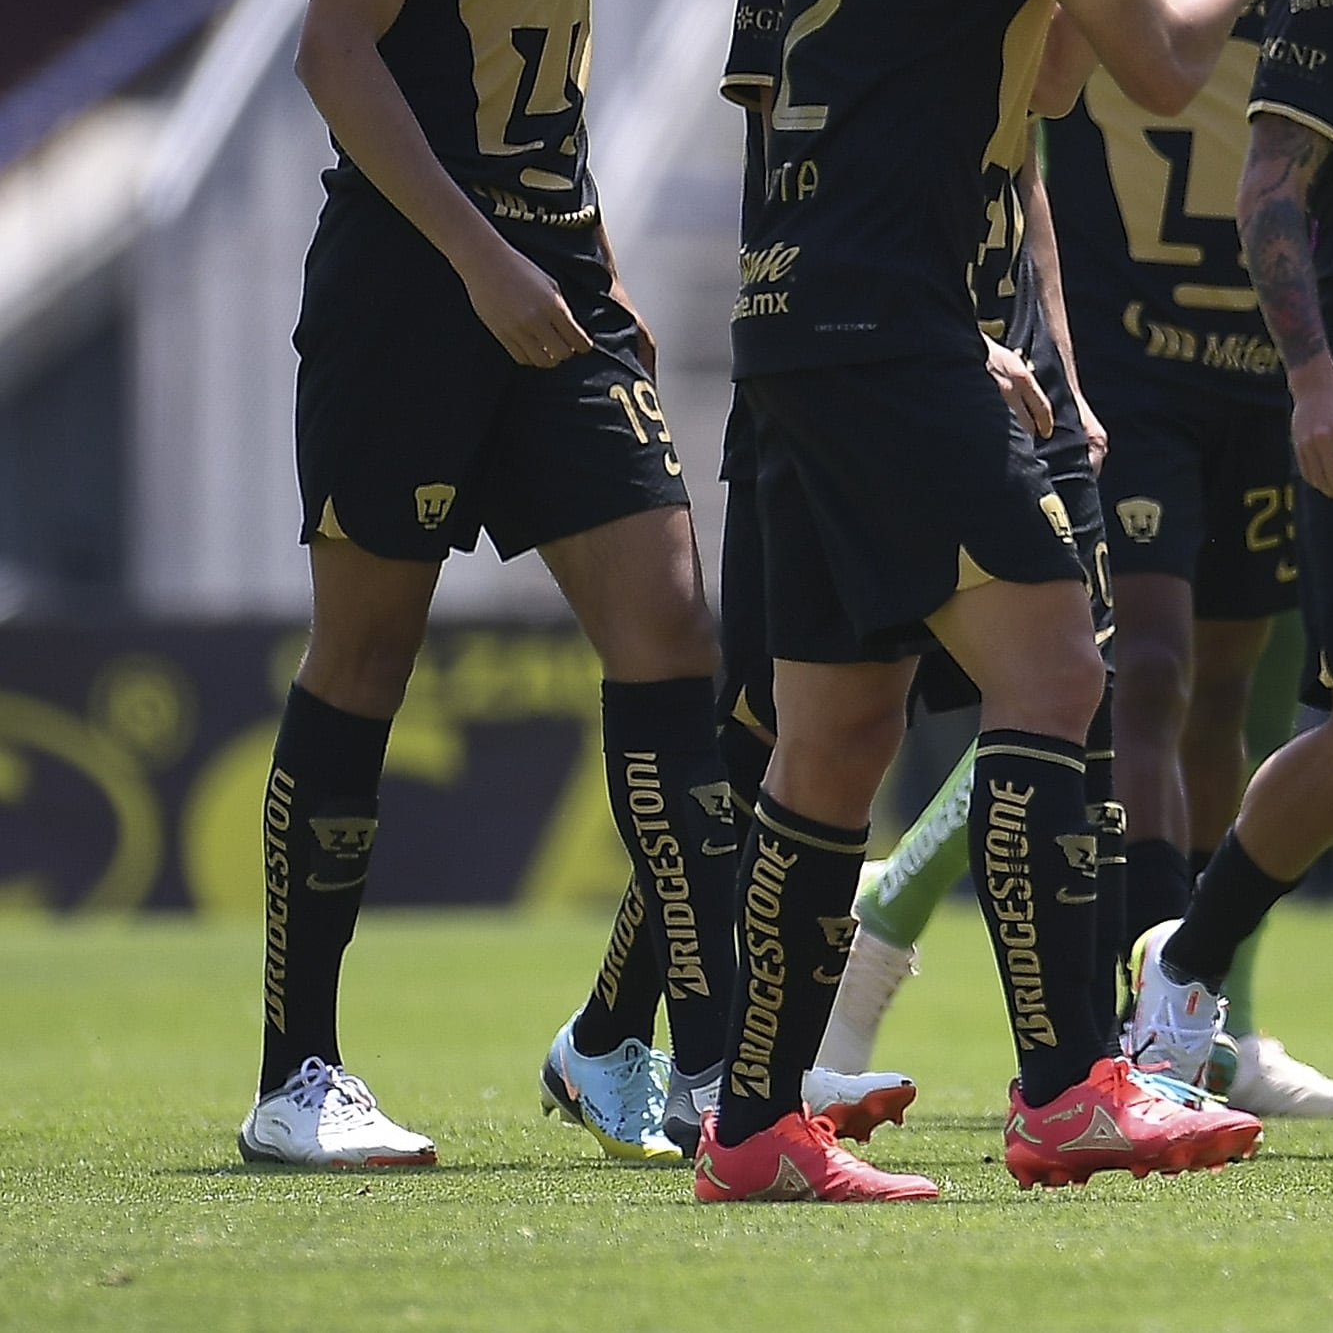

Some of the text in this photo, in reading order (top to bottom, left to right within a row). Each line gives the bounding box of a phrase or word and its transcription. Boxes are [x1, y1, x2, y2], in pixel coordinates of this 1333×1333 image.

[1269, 36, 1327, 70] GNP
[265, 767, 296, 1035] BRIDGESTON
[730, 834, 798, 1100] BRIDGESTONE
[985, 778, 1059, 1051] BRIDGESTONE
